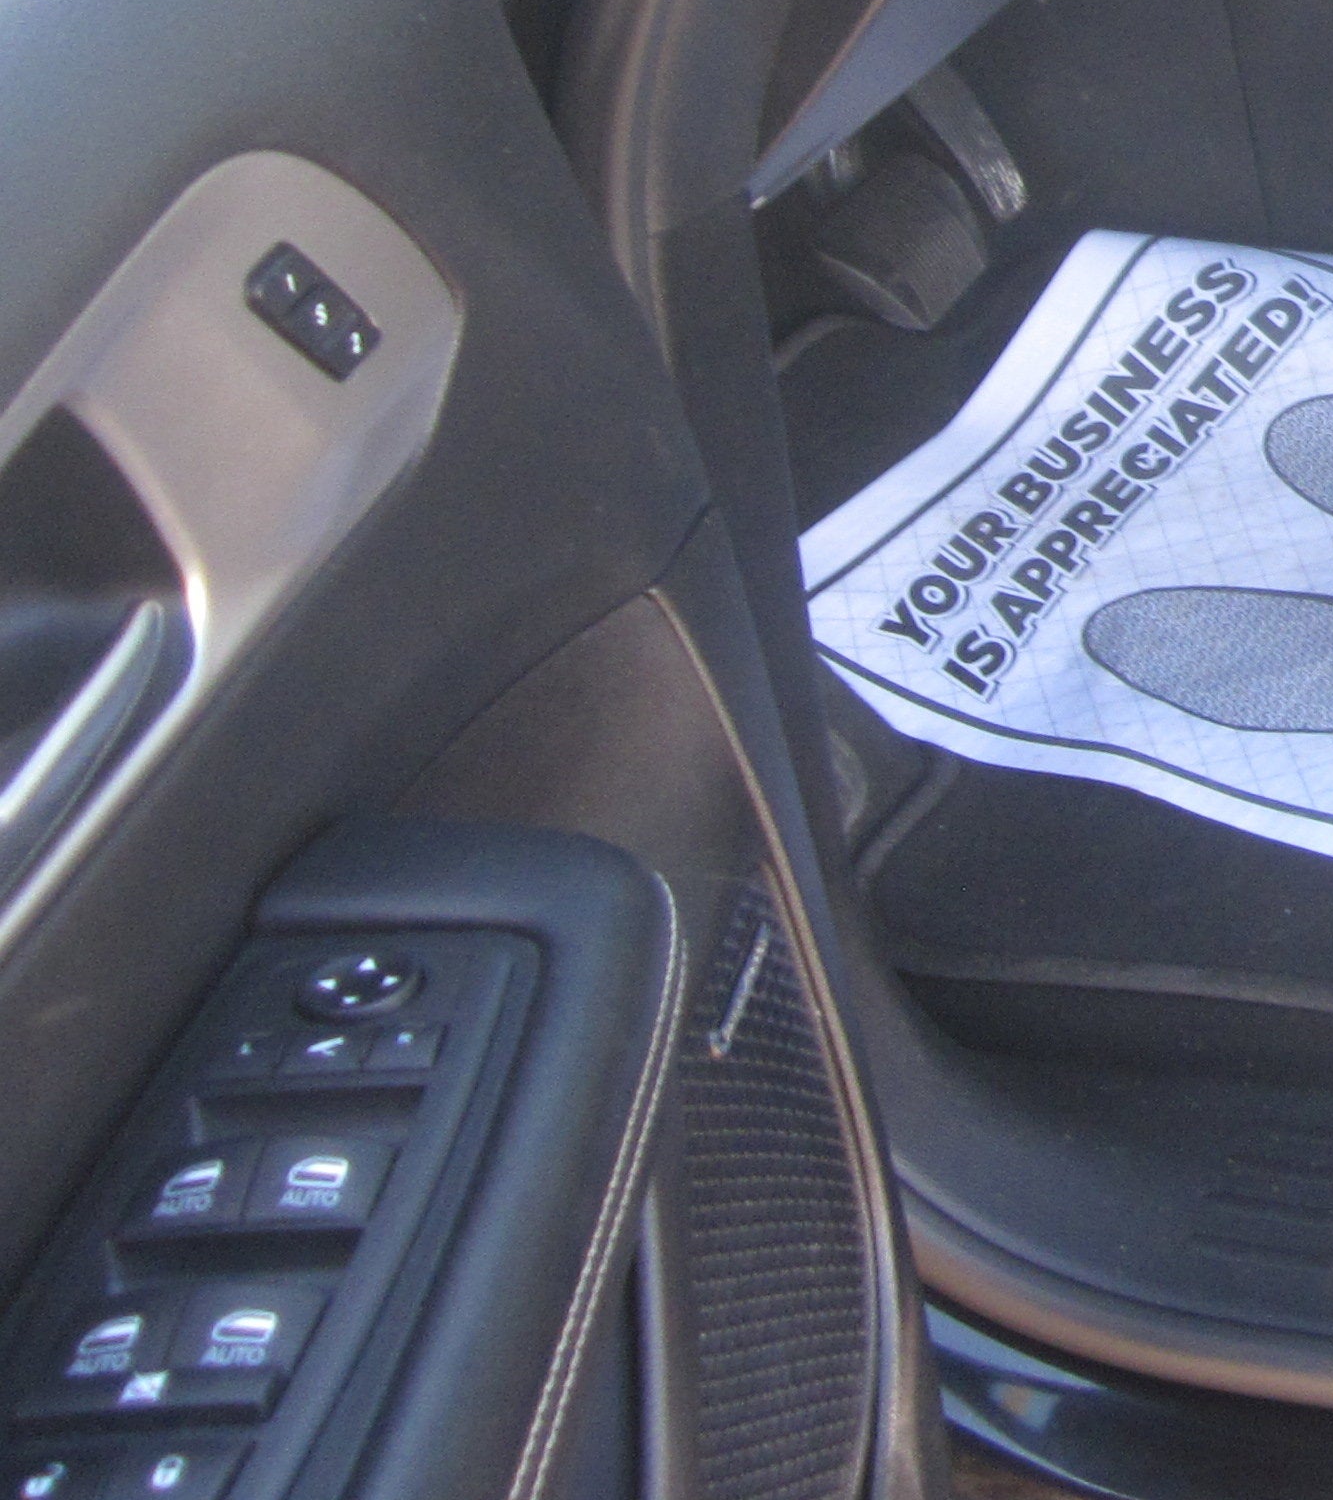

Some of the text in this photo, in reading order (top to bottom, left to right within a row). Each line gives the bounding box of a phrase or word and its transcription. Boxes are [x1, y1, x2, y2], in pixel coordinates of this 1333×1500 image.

[879, 261, 1248, 647] YOUR BUSINESS
[942, 278, 1322, 696] IS APPRECIATED!
[153, 1192, 212, 1216] AUTO
[279, 1188, 340, 1208] AUTO
[66, 1351, 132, 1376] AUTO
[200, 1345, 266, 1367] AUTO
